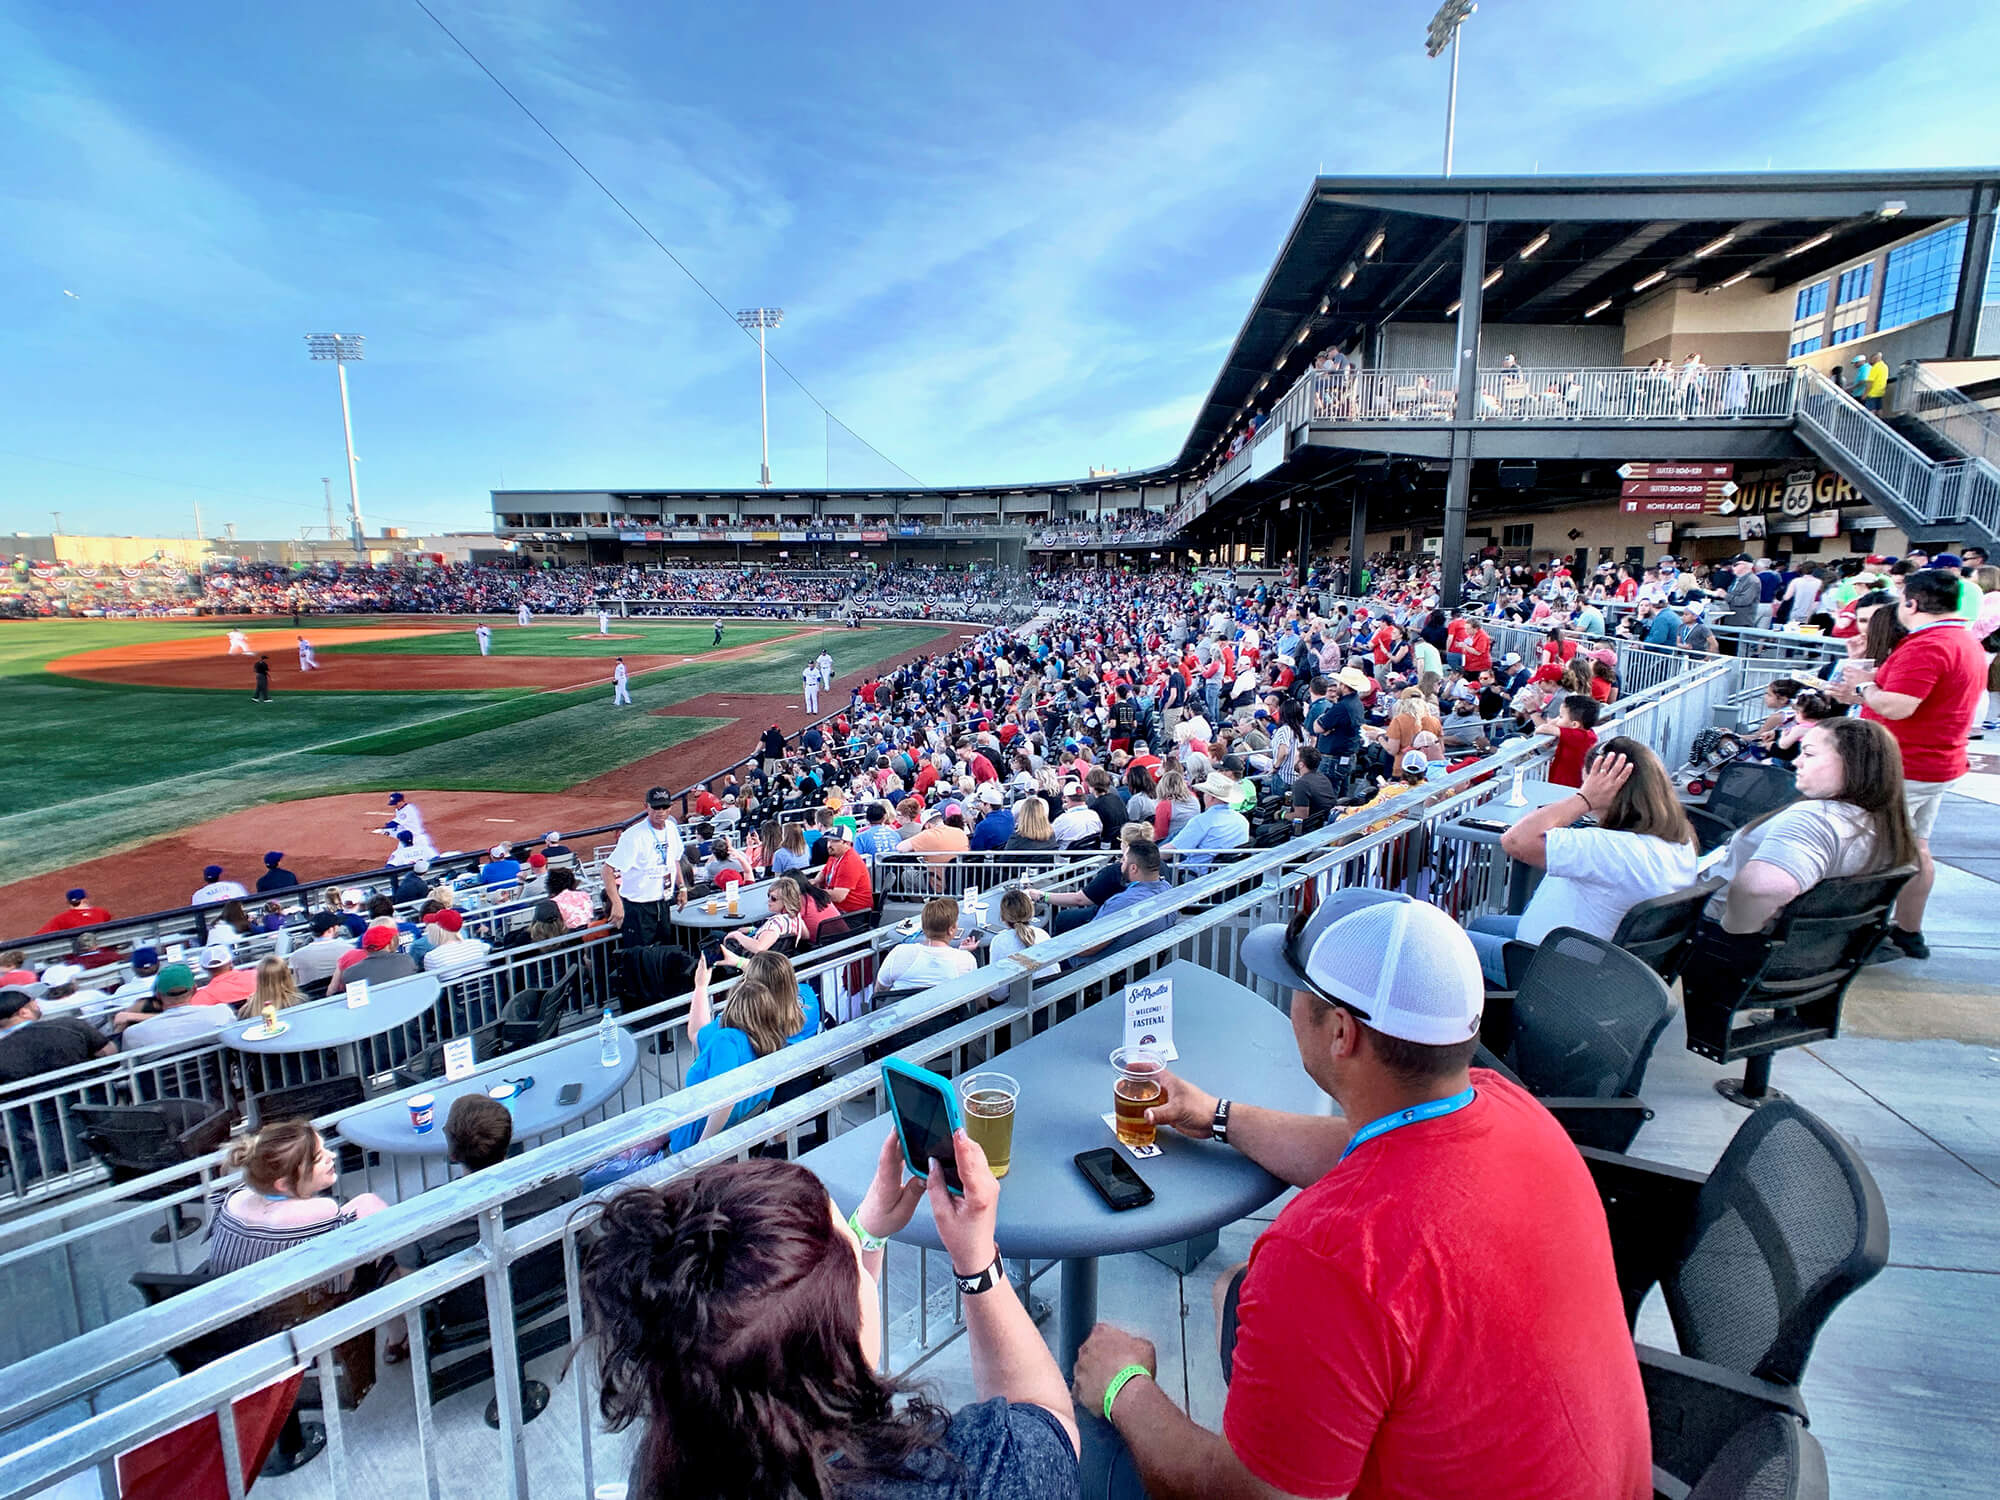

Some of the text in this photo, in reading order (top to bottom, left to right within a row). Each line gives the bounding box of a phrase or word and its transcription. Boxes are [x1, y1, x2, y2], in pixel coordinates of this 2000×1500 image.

[1792, 473, 1812, 482] TEXAS
[1787, 486, 1809, 510] 66
[1128, 984, 1169, 1004] Sod Poodles
[1135, 1006, 1162, 1016] WELCOME!
[1133, 1015, 1165, 1029] FASTENAL
